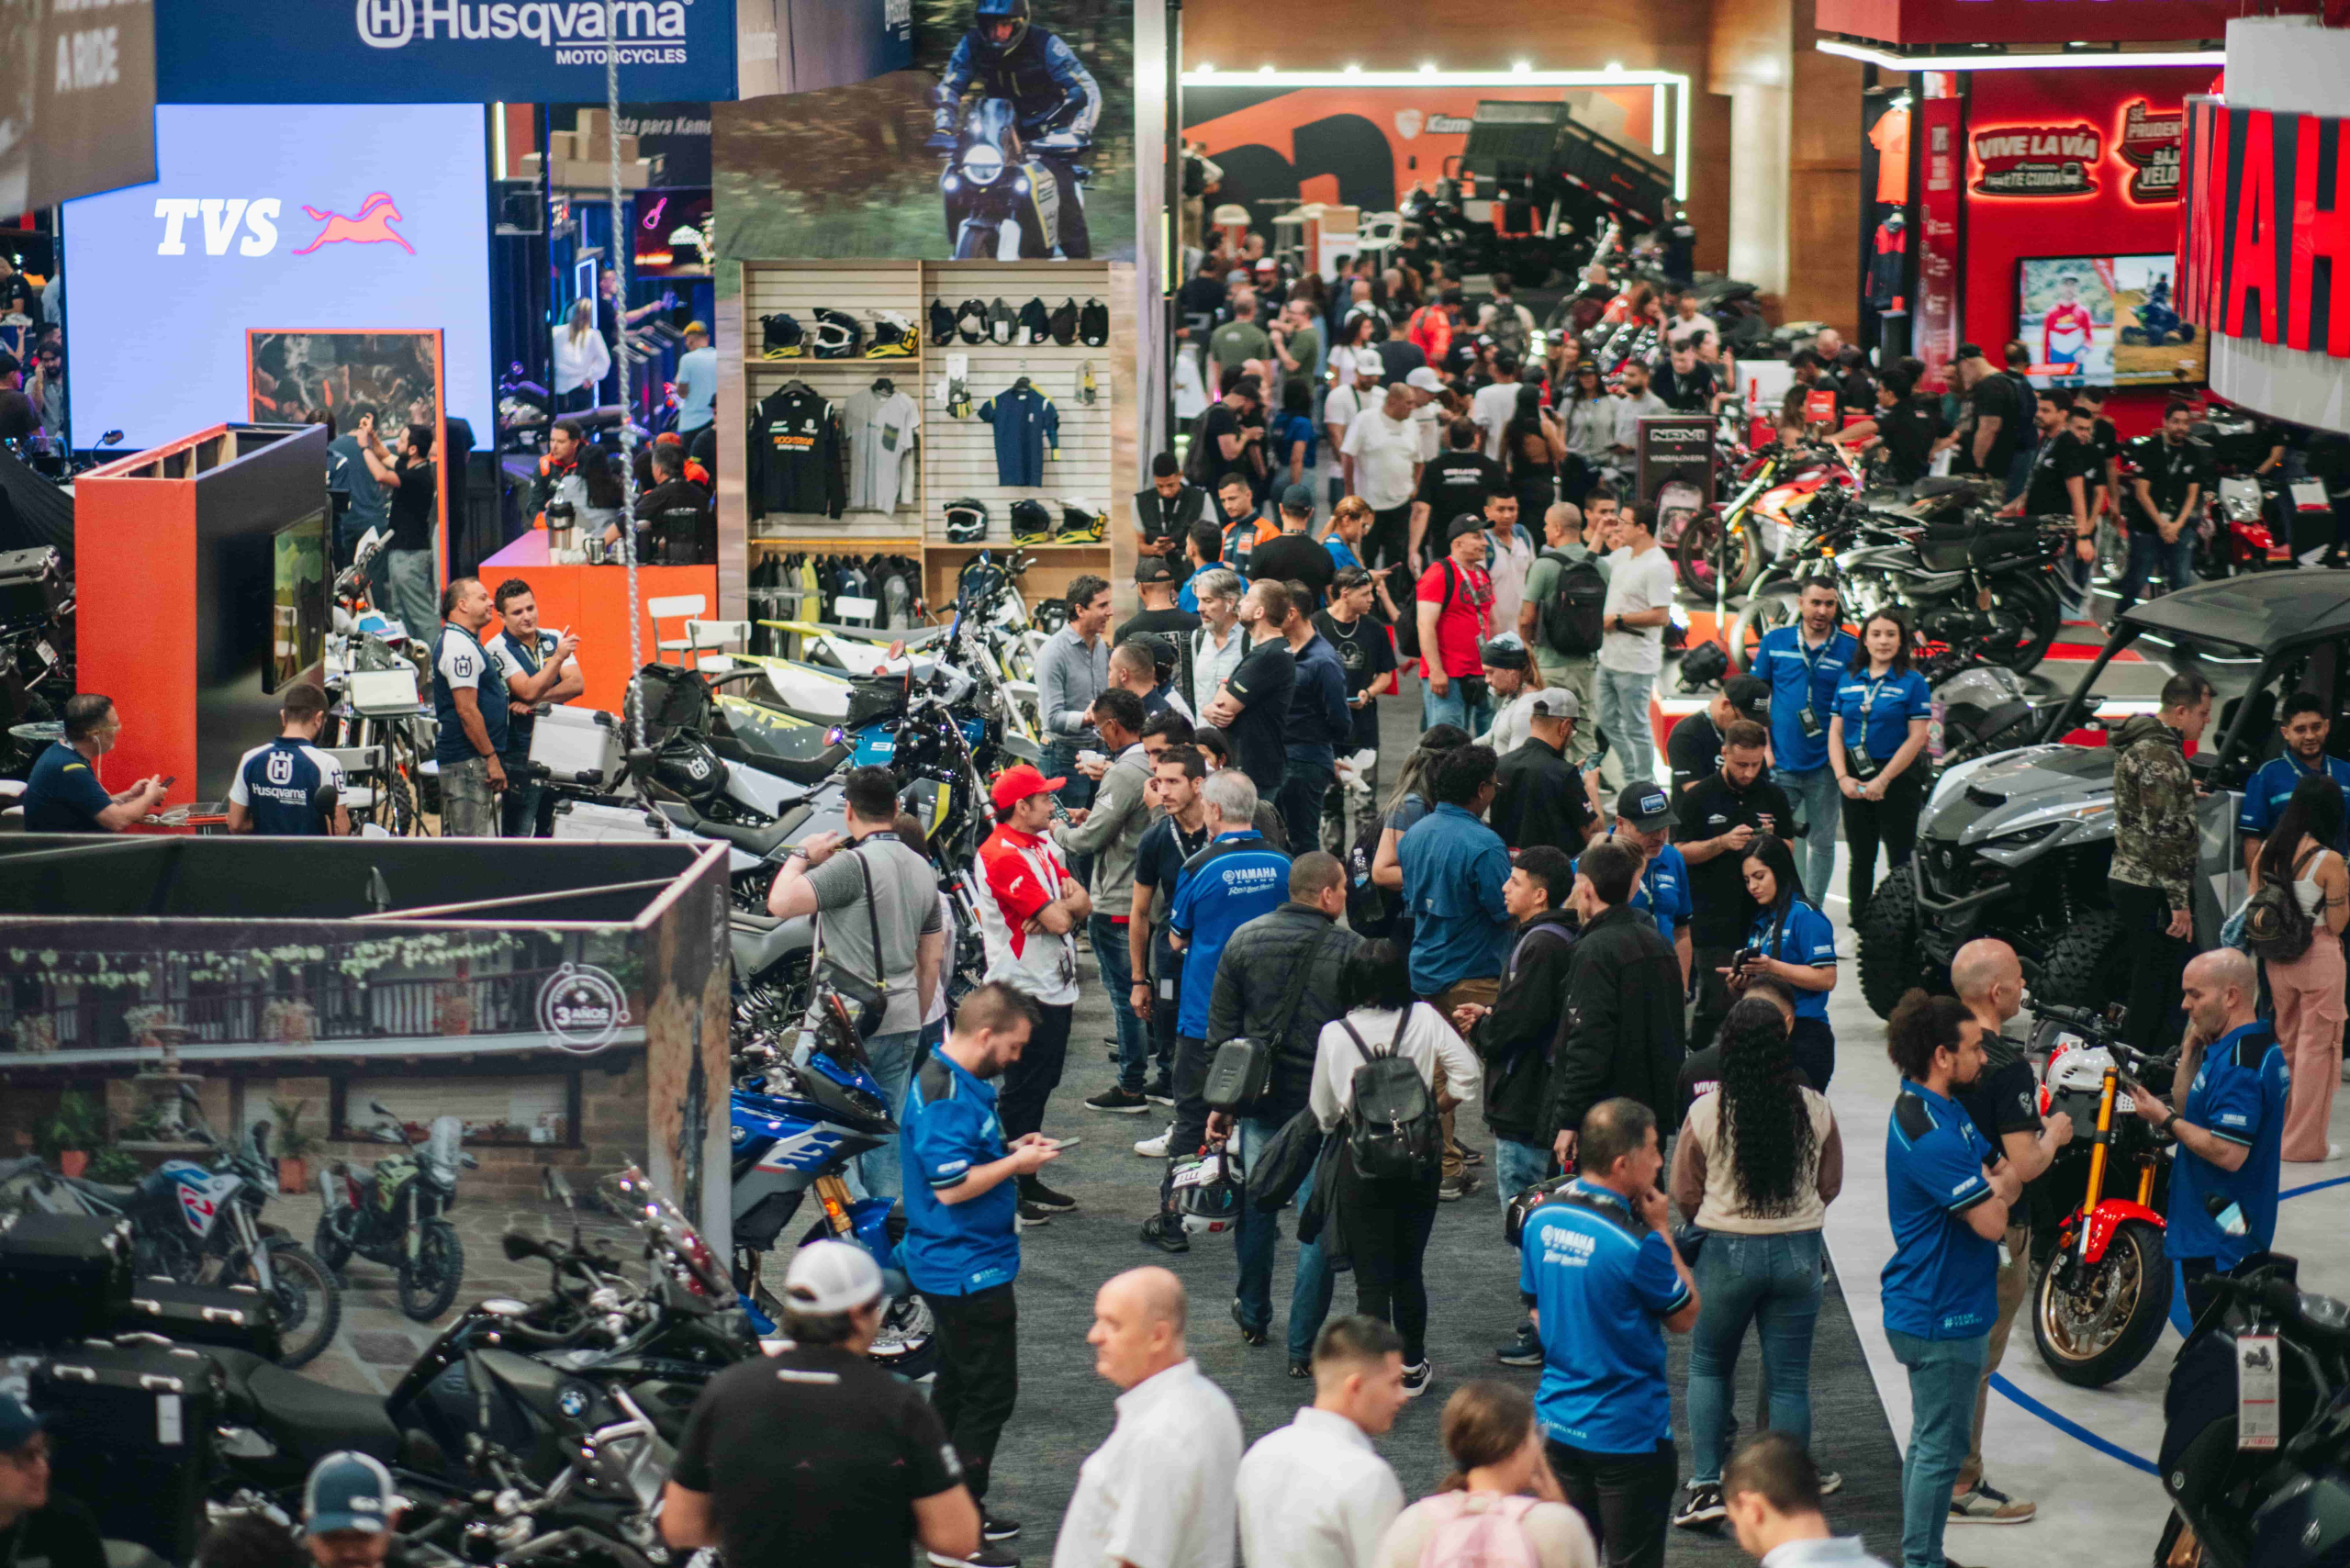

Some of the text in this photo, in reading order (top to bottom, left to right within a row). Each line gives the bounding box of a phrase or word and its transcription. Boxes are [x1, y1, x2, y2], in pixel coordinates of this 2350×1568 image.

[423, 0, 686, 46] Husqvarna
[555, 49, 687, 65] MOTORCYCLES
[1975, 136, 2029, 160] VIVE
[2030, 135, 2059, 155] LA
[2061, 131, 2098, 160] VÍA
[154, 198, 282, 257] TVS
[1651, 429, 1707, 442] NAVI
[252, 782, 307, 800] Husqvarna
[1234, 867, 1278, 880] YAMAHA
[554, 1005, 610, 1026] 3 AÑOS
[1553, 1227, 1596, 1253] YAMAHA
